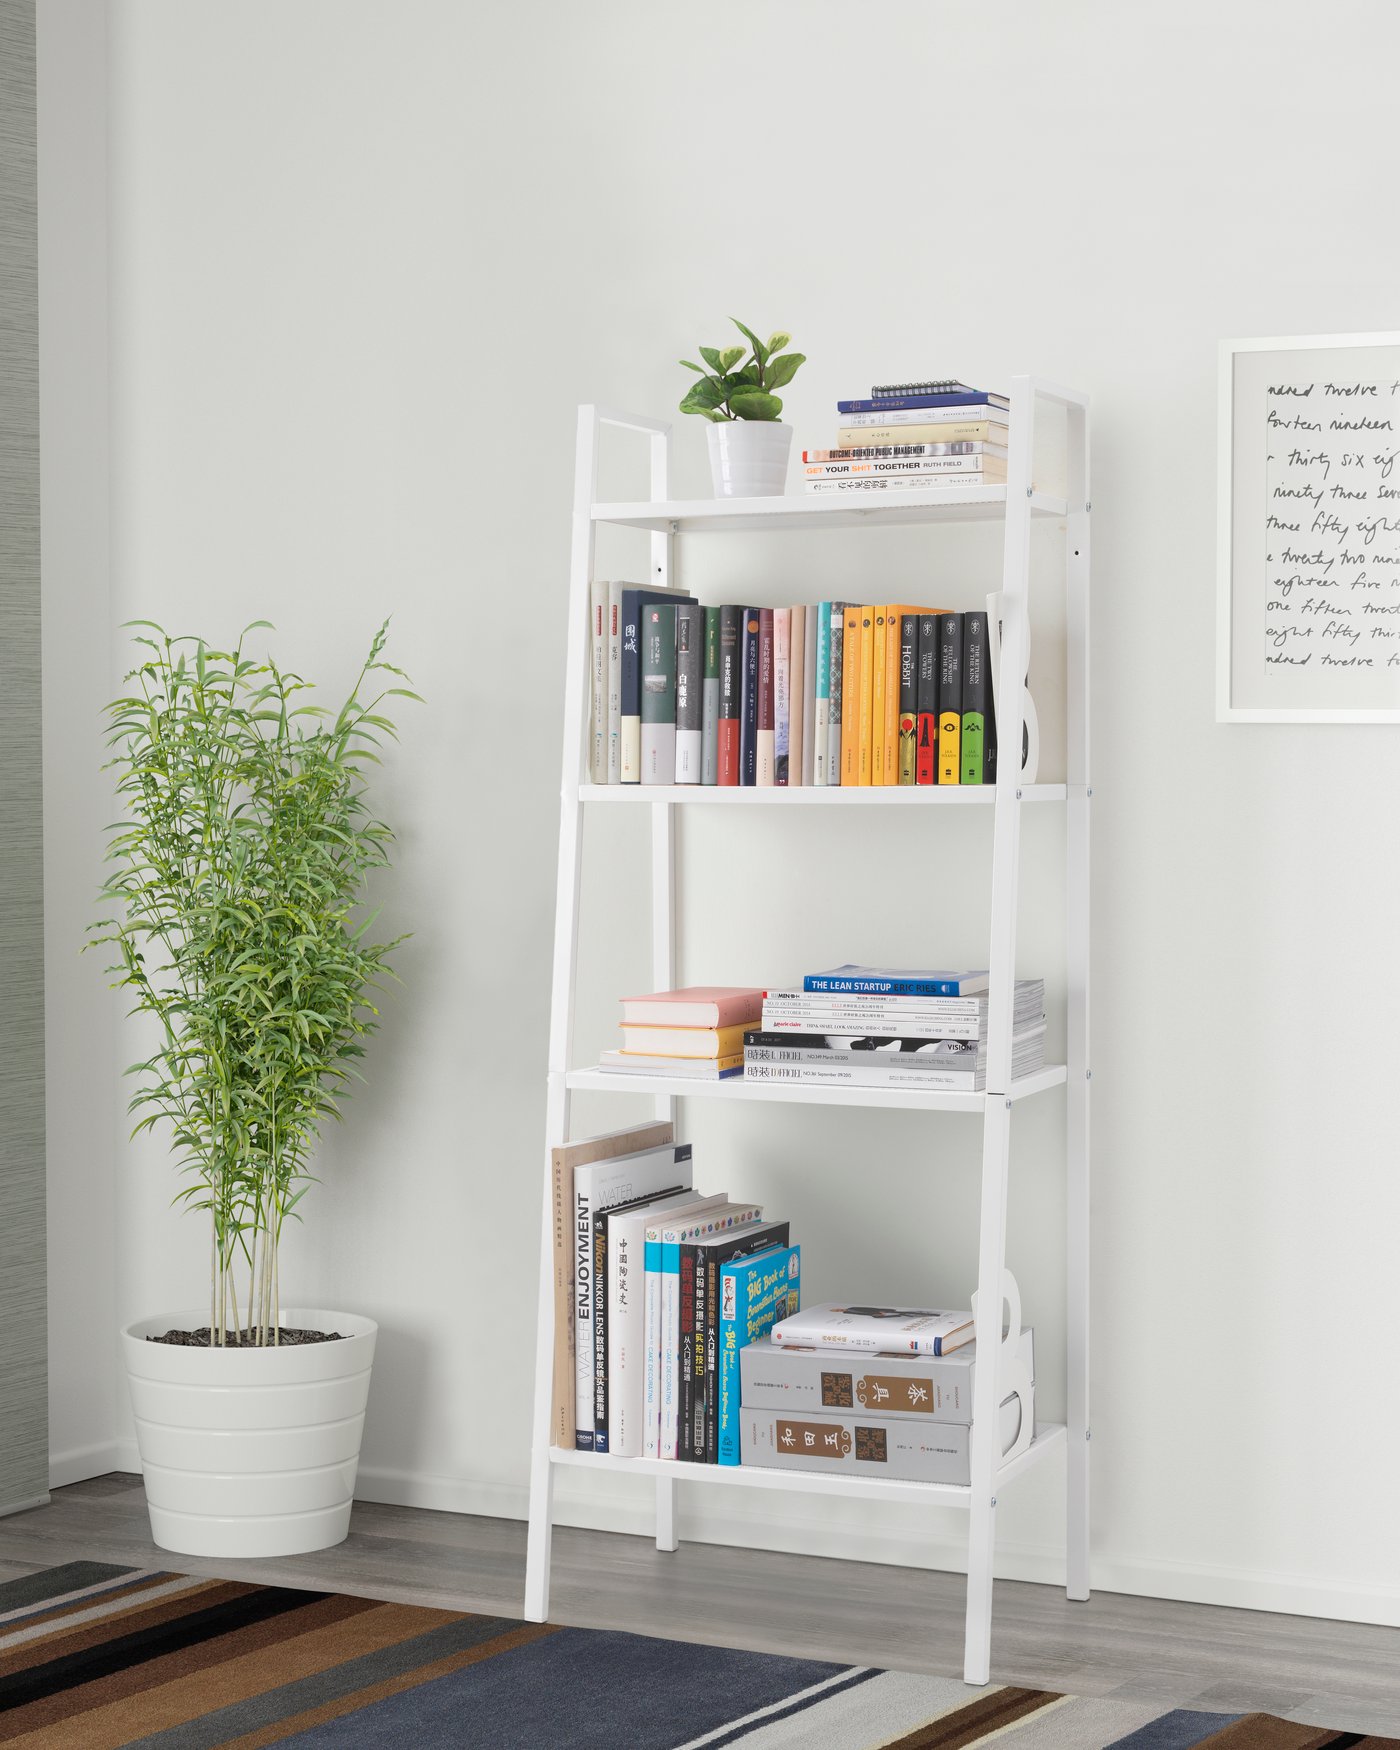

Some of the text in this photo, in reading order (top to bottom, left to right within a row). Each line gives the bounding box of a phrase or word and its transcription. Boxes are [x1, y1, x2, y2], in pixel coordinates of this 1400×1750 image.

[1324, 383, 1378, 396] twelve
[1268, 410, 1393, 432] fourteen nineteen
[829, 445, 926, 459] OUTCOME-ORIENTED PUBLIC MANAGEMENT
[1288, 448, 1330, 480] thirty
[1342, 453, 1364, 468] six
[851, 464, 872, 472] SHIT
[874, 462, 920, 471] TOGETHER
[1274, 482, 1324, 509] ninety
[1330, 484, 1367, 500] three
[1266, 515, 1300, 532] three
[1311, 511, 1348, 544] fifty
[1282, 547, 1334, 574] twenty
[1340, 549, 1365, 566] two
[1274, 568, 1380, 597] eighteen five
[1266, 601, 1291, 611] one
[1301, 598, 1352, 615] fifteen
[1266, 621, 1360, 647] eight fifty
[943, 645, 948, 654] OF
[970, 644, 974, 653] OF
[1321, 654, 1374, 666] twelve
[902, 645, 911, 688] HOBBIT
[679, 674, 687, 708] 白鹿原
[812, 980, 937, 993] THE LEAN STARTUP ERIC RIES
[599, 1183, 632, 1205] WATER
[578, 1192, 590, 1320] ENJOYMENT
[595, 1233, 606, 1274] Nikon
[747, 1266, 785, 1302] BIG Book of
[748, 1270, 757, 1282] The
[596, 1274, 604, 1310] NIKKOR
[696, 1266, 704, 1331] 数码单反摄影
[596, 1312, 604, 1335] LENS
[747, 1312, 774, 1337] Beginner
[725, 1331, 736, 1348] BIG
[872, 1382, 928, 1406] 茶具
[781, 1427, 839, 1450] 和田玉
